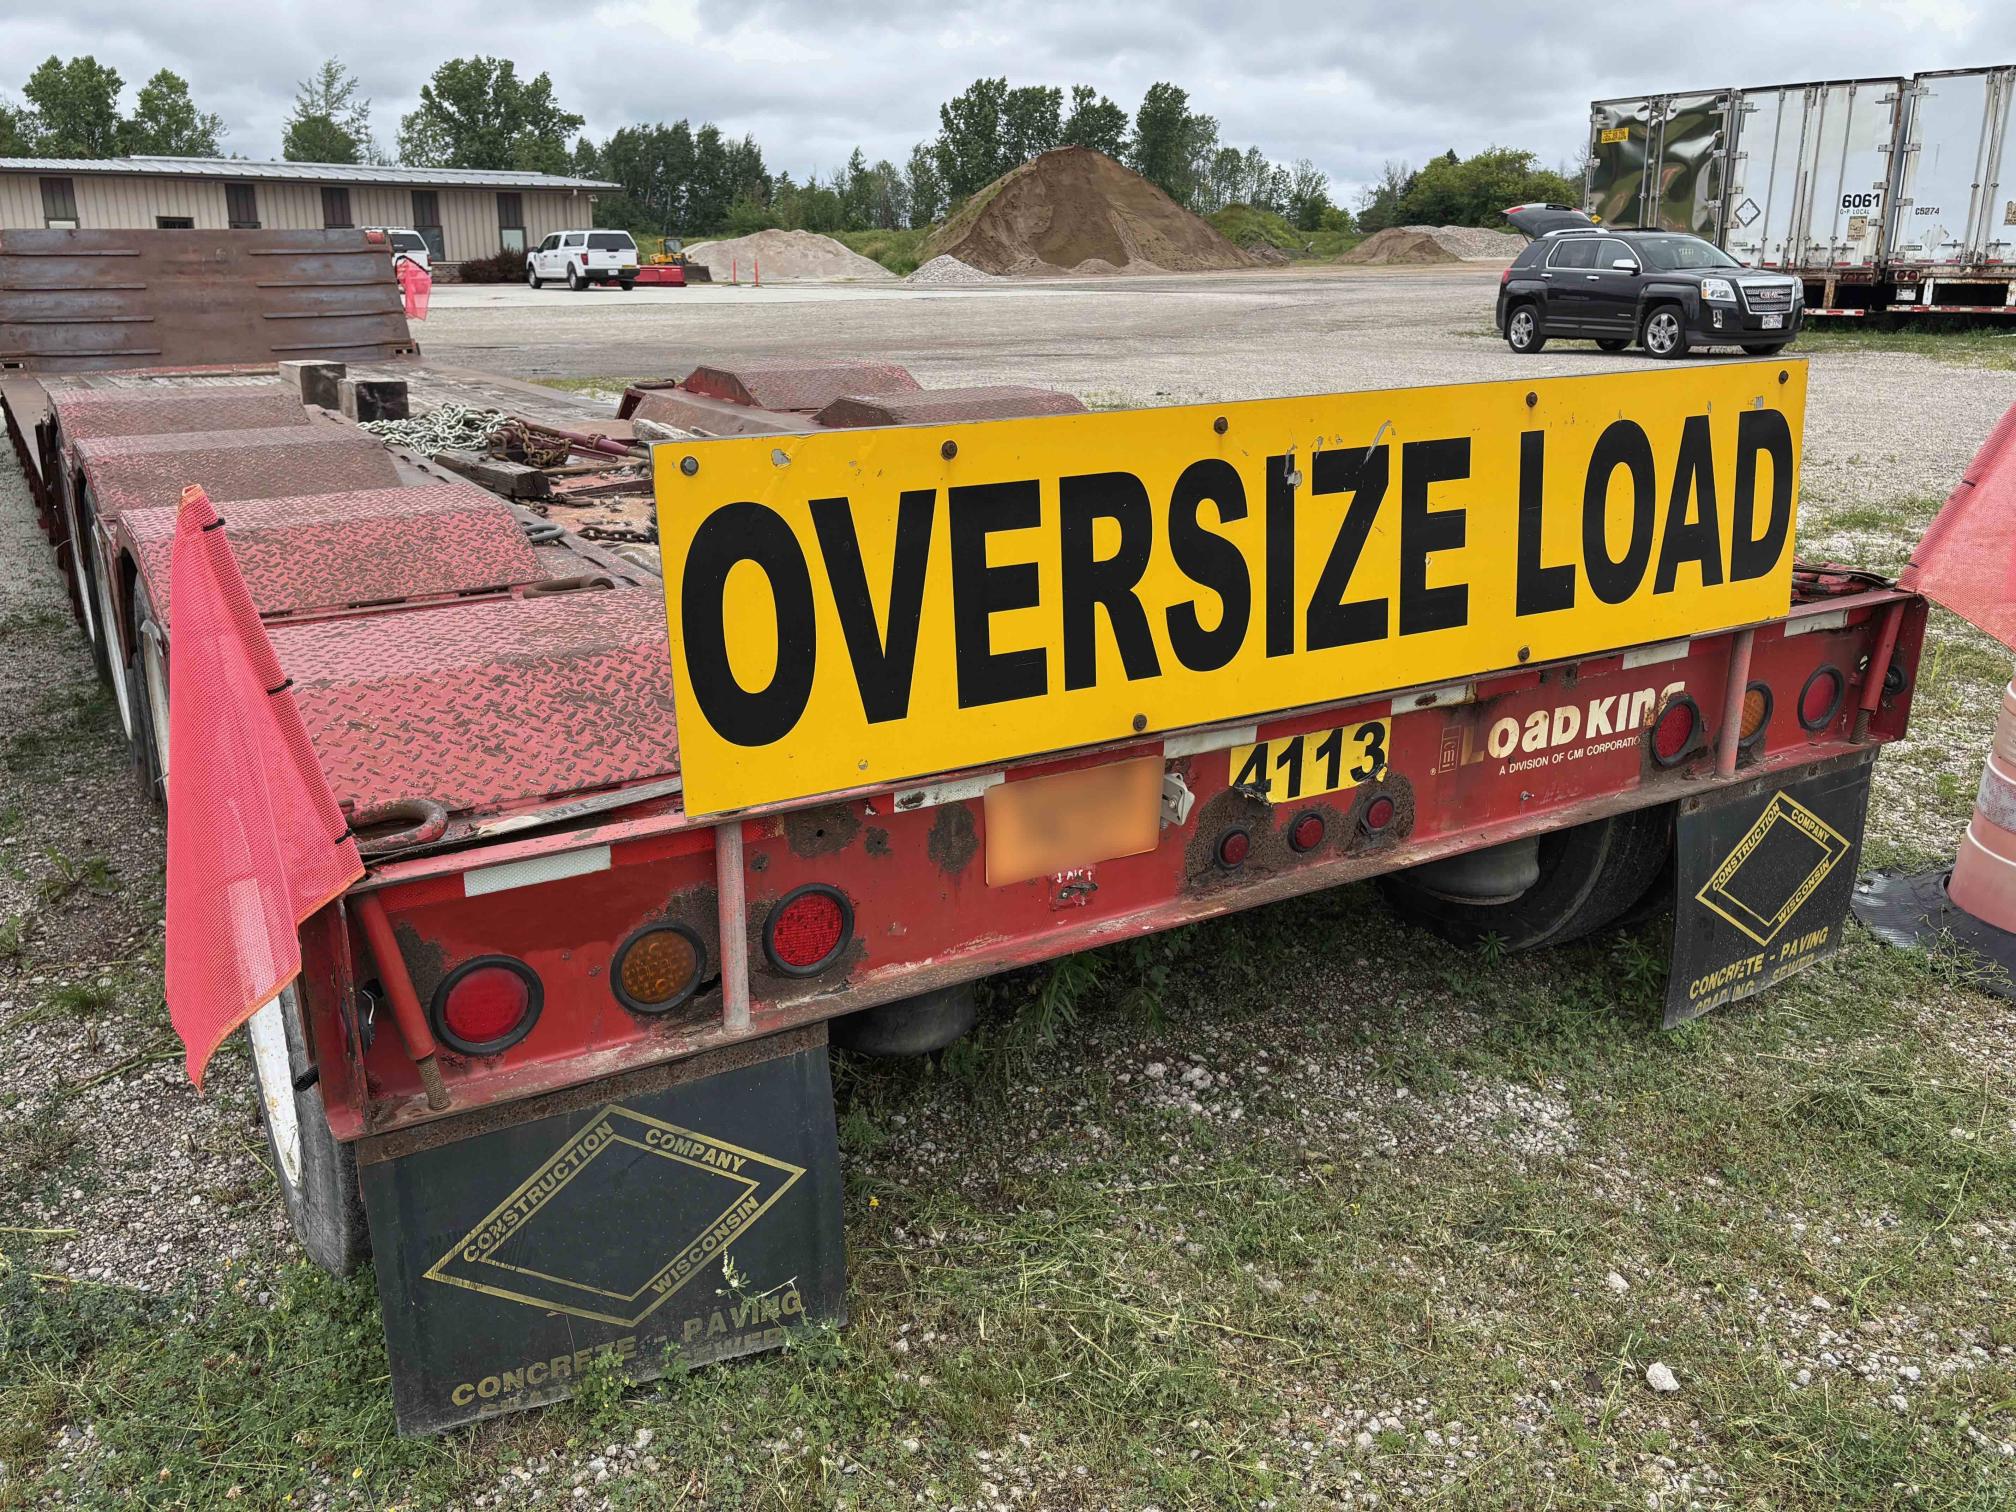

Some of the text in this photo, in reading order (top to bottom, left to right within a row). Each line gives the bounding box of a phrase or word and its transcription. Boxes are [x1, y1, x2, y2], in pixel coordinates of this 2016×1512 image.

[1842, 193, 1880, 208] 6061
[681, 408, 1794, 747] OVERSIZE LOAD
[1232, 721, 1386, 799] 4113
[1499, 735, 1642, 776] A DIVISION OF CMI CORPORATIO
[1712, 802, 1781, 892] CONSTRUCTION
[1791, 809, 1831, 843] COMPANY
[1777, 859, 1831, 923] WISCONSIN
[1689, 953, 1765, 1000] CONCRETE
[1780, 926, 1829, 961] PAVING
[645, 1128, 748, 1174] COMPANY
[463, 1121, 614, 1263] CONSTRUCTION
[651, 1195, 761, 1295] WISCONSIN
[452, 1335, 637, 1407] CONCRETE
[683, 1289, 804, 1343] PAVING
